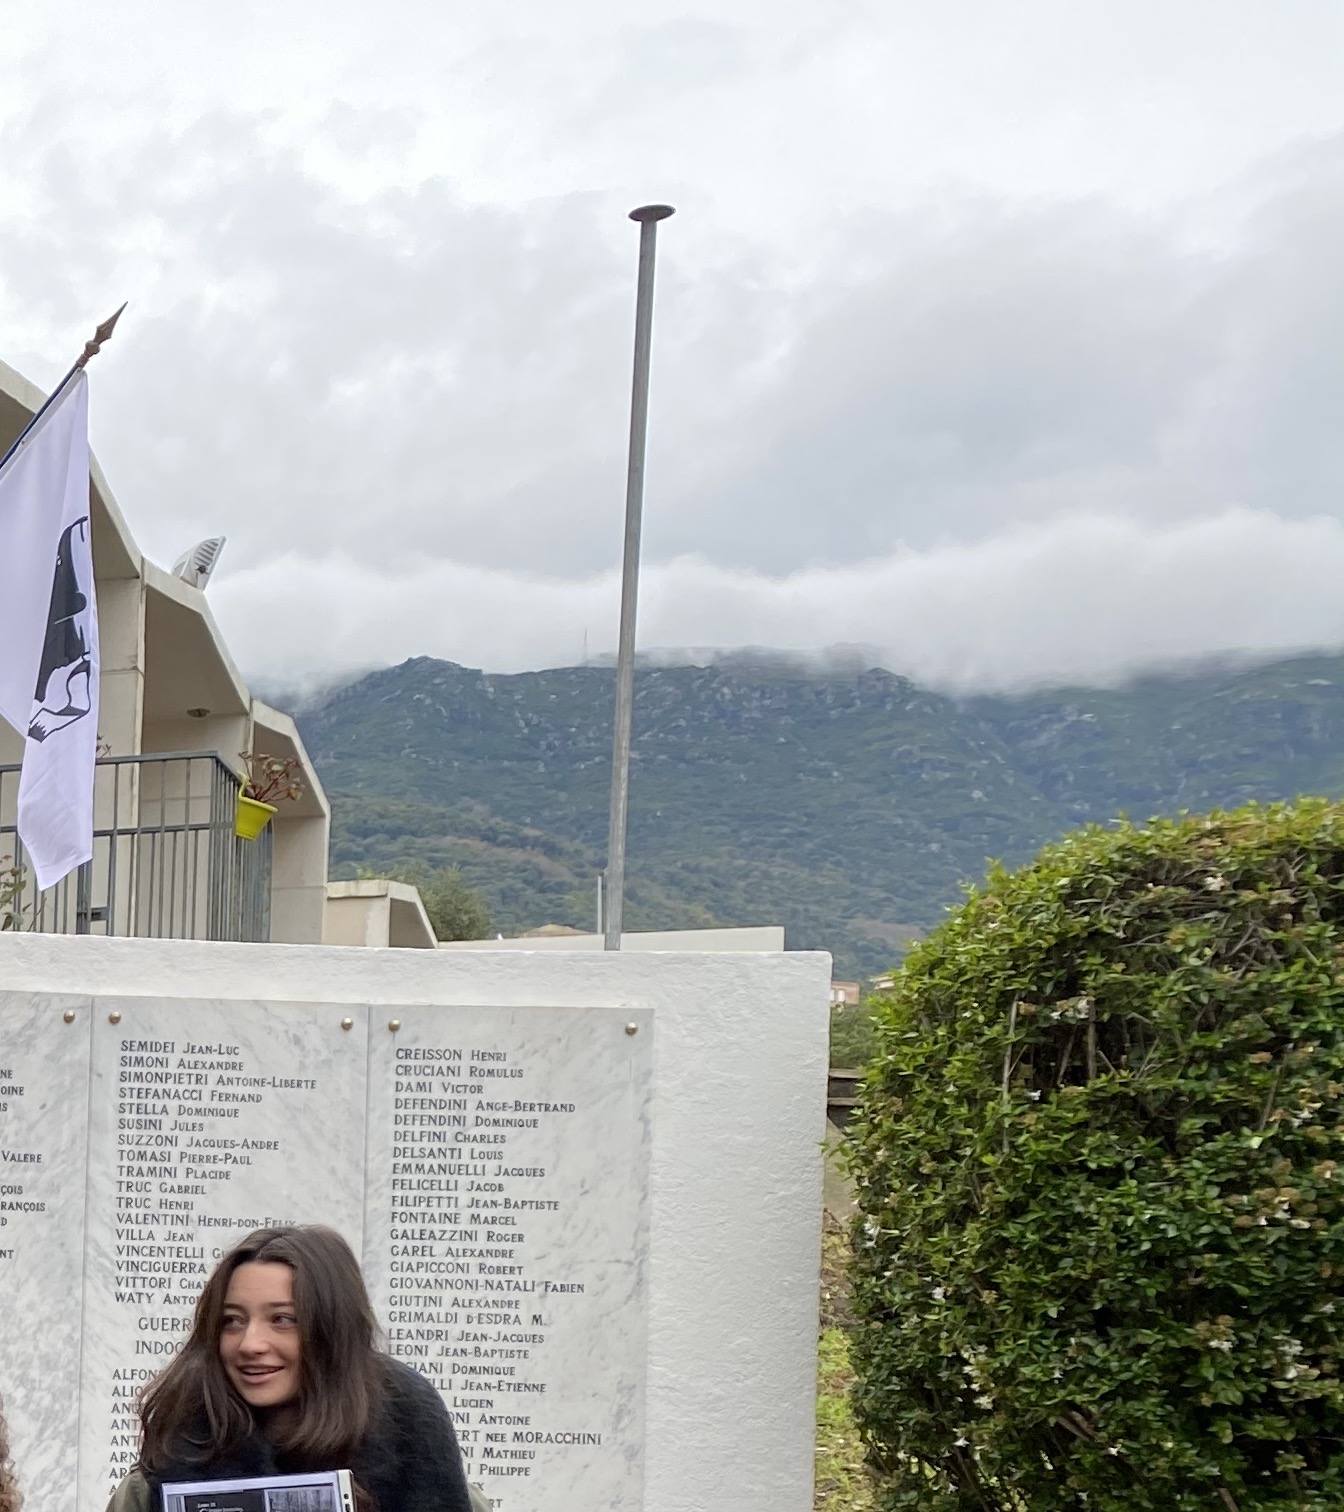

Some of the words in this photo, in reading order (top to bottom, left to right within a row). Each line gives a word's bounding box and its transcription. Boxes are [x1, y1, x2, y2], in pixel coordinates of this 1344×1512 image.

[121, 1040, 175, 1054] SEMIDEI
[396, 1049, 462, 1061] CREISSON
[120, 1056, 169, 1069] SIMONI
[395, 1065, 460, 1077] CRUCIANI
[119, 1071, 208, 1085] SIMONPIETRI
[119, 1087, 202, 1101] STEFANACCI
[395, 1082, 432, 1093] DAMI
[118, 1103, 169, 1116] STELLA
[394, 1099, 466, 1111] DEFENDINI
[118, 1119, 162, 1131] SUSINI
[394, 1114, 466, 1127] DEFENDINI
[118, 1135, 178, 1147] SUZZONI
[394, 1131, 446, 1143] DELFINI
[118, 1150, 171, 1163] TOMASI
[393, 1147, 462, 1160] DELSANTI
[117, 1165, 177, 1178] TRAMINI
[393, 1163, 486, 1176] EMMANUELLI
[116, 1181, 152, 1193] TRUC
[392, 1179, 458, 1192] FELICELLI
[116, 1197, 151, 1209] TRUC
[391, 1195, 458, 1208] FILIPETTI
[116, 1213, 189, 1227] VALENTINI
[391, 1212, 461, 1224] FONTAINE
[116, 1229, 155, 1242] VILLA
[390, 1229, 478, 1242] GALEAZZINI
[116, 1245, 204, 1259] VINCENTELLI
[390, 1245, 436, 1257] GAREL
[116, 1260, 207, 1274] VINCIGUERRA
[115, 1277, 171, 1289] VITTORI
[115, 1292, 154, 1304] WATY
[388, 1311, 458, 1323] GRIMALDI
[513, 1431, 602, 1446] MORACCHINI
